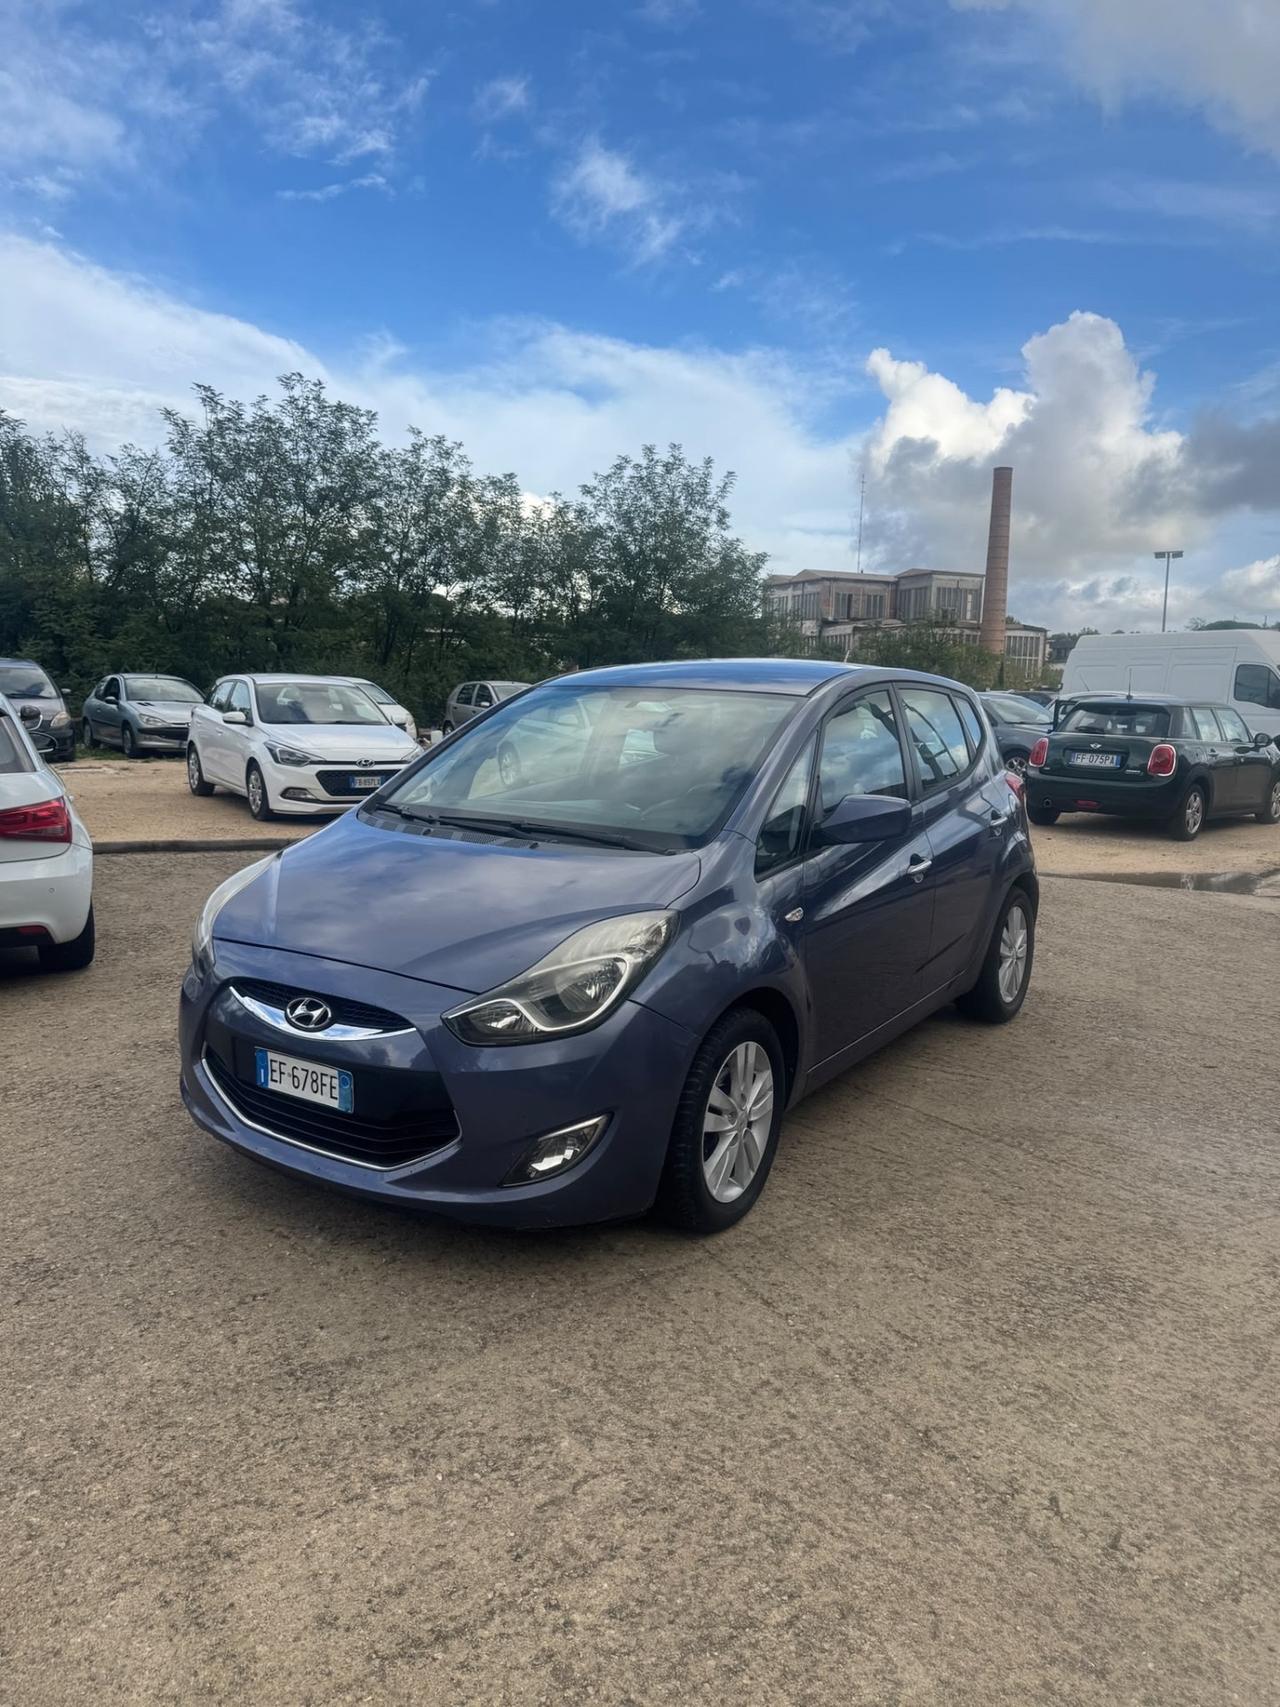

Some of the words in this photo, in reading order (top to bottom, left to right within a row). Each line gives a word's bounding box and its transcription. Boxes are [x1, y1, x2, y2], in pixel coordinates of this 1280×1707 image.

[1076, 753, 1087, 763] FF
[1088, 754, 1115, 765] 075PA
[270, 1059, 287, 1084] EF
[291, 1066, 339, 1101] 678FE
